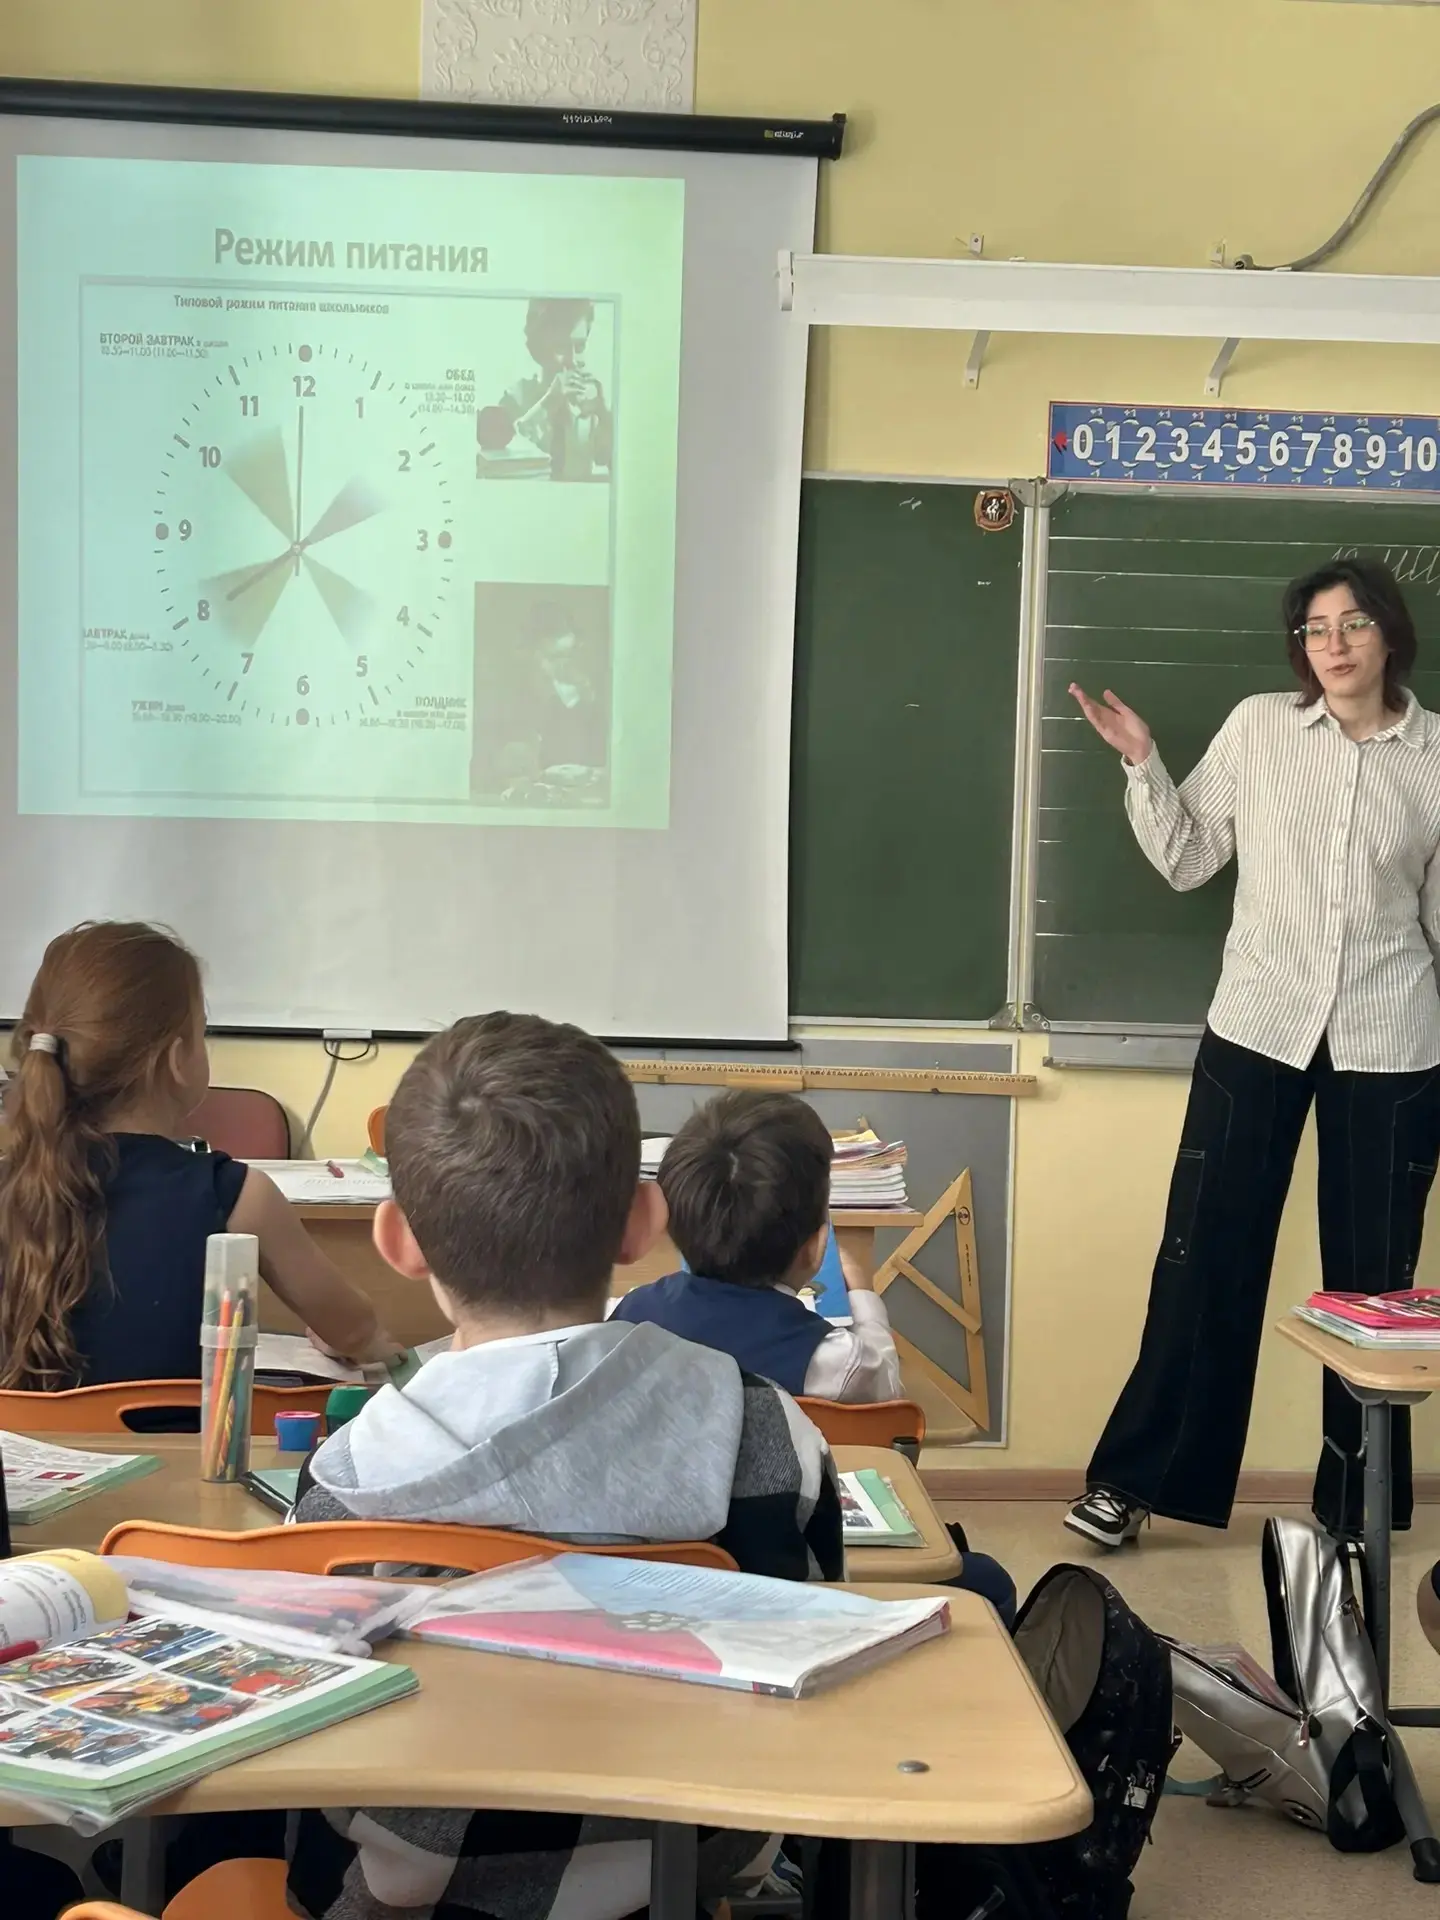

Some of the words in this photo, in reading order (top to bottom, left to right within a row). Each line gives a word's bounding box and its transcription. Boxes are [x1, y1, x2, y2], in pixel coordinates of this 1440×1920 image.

[214, 228, 335, 268] Режим
[346, 241, 489, 274] питания
[174, 294, 223, 309] Типовой
[100, 332, 143, 345] ВТОРОЙ
[146, 334, 195, 347] ЗАВТРАК
[292, 375, 316, 398] 12
[239, 395, 260, 417] 11
[355, 397, 364, 419] 1
[198, 446, 222, 468] 10
[1072, 424, 1094, 460] 0
[1105, 425, 1121, 460] 1
[1135, 426, 1157, 461] 2
[1169, 427, 1190, 463] 3
[1201, 428, 1224, 464] 4
[1236, 430, 1257, 465] 5
[1269, 431, 1290, 466] 6
[1301, 432, 1322, 467] 7
[1333, 433, 1353, 468] 8
[1366, 434, 1386, 470] 9
[1398, 436, 1437, 472] 10
[398, 450, 411, 472] 2
[178, 519, 192, 541] 9
[416, 529, 429, 552] 3
[197, 599, 211, 621] 8
[396, 605, 410, 626] 4
[240, 652, 254, 675] 7
[355, 655, 368, 678] 5
[296, 674, 310, 696] 6
